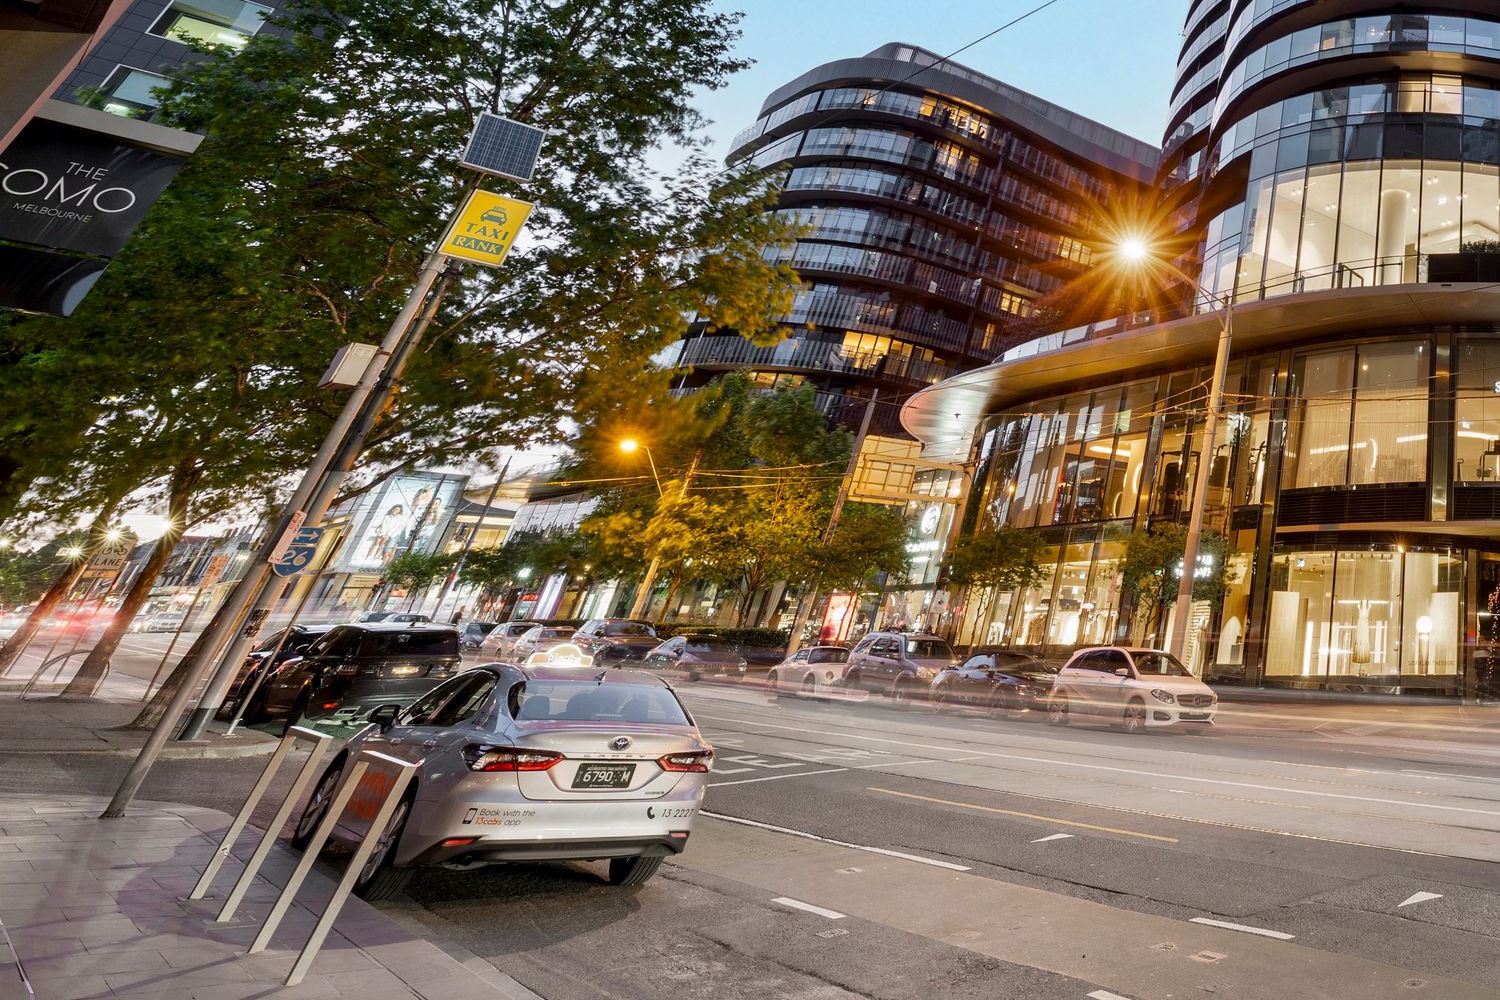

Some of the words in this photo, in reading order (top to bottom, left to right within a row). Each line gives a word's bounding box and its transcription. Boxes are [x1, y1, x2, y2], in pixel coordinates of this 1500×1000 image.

[65, 161, 109, 181] THE
[0, 162, 136, 213] OMO
[13, 202, 93, 223] MELBOURNE
[466, 222, 509, 240] TAXI
[456, 238, 498, 253] RANK
[94, 558, 122, 567] LANE
[277, 550, 308, 566] 26
[582, 771, 614, 782] 6790
[620, 771, 631, 782] M
[480, 808, 500, 817] Book
[503, 809, 521, 817] with
[522, 809, 536, 817] the
[661, 808, 672, 818] 13
[673, 808, 695, 818] 2227
[475, 817, 502, 825] 13cabs
